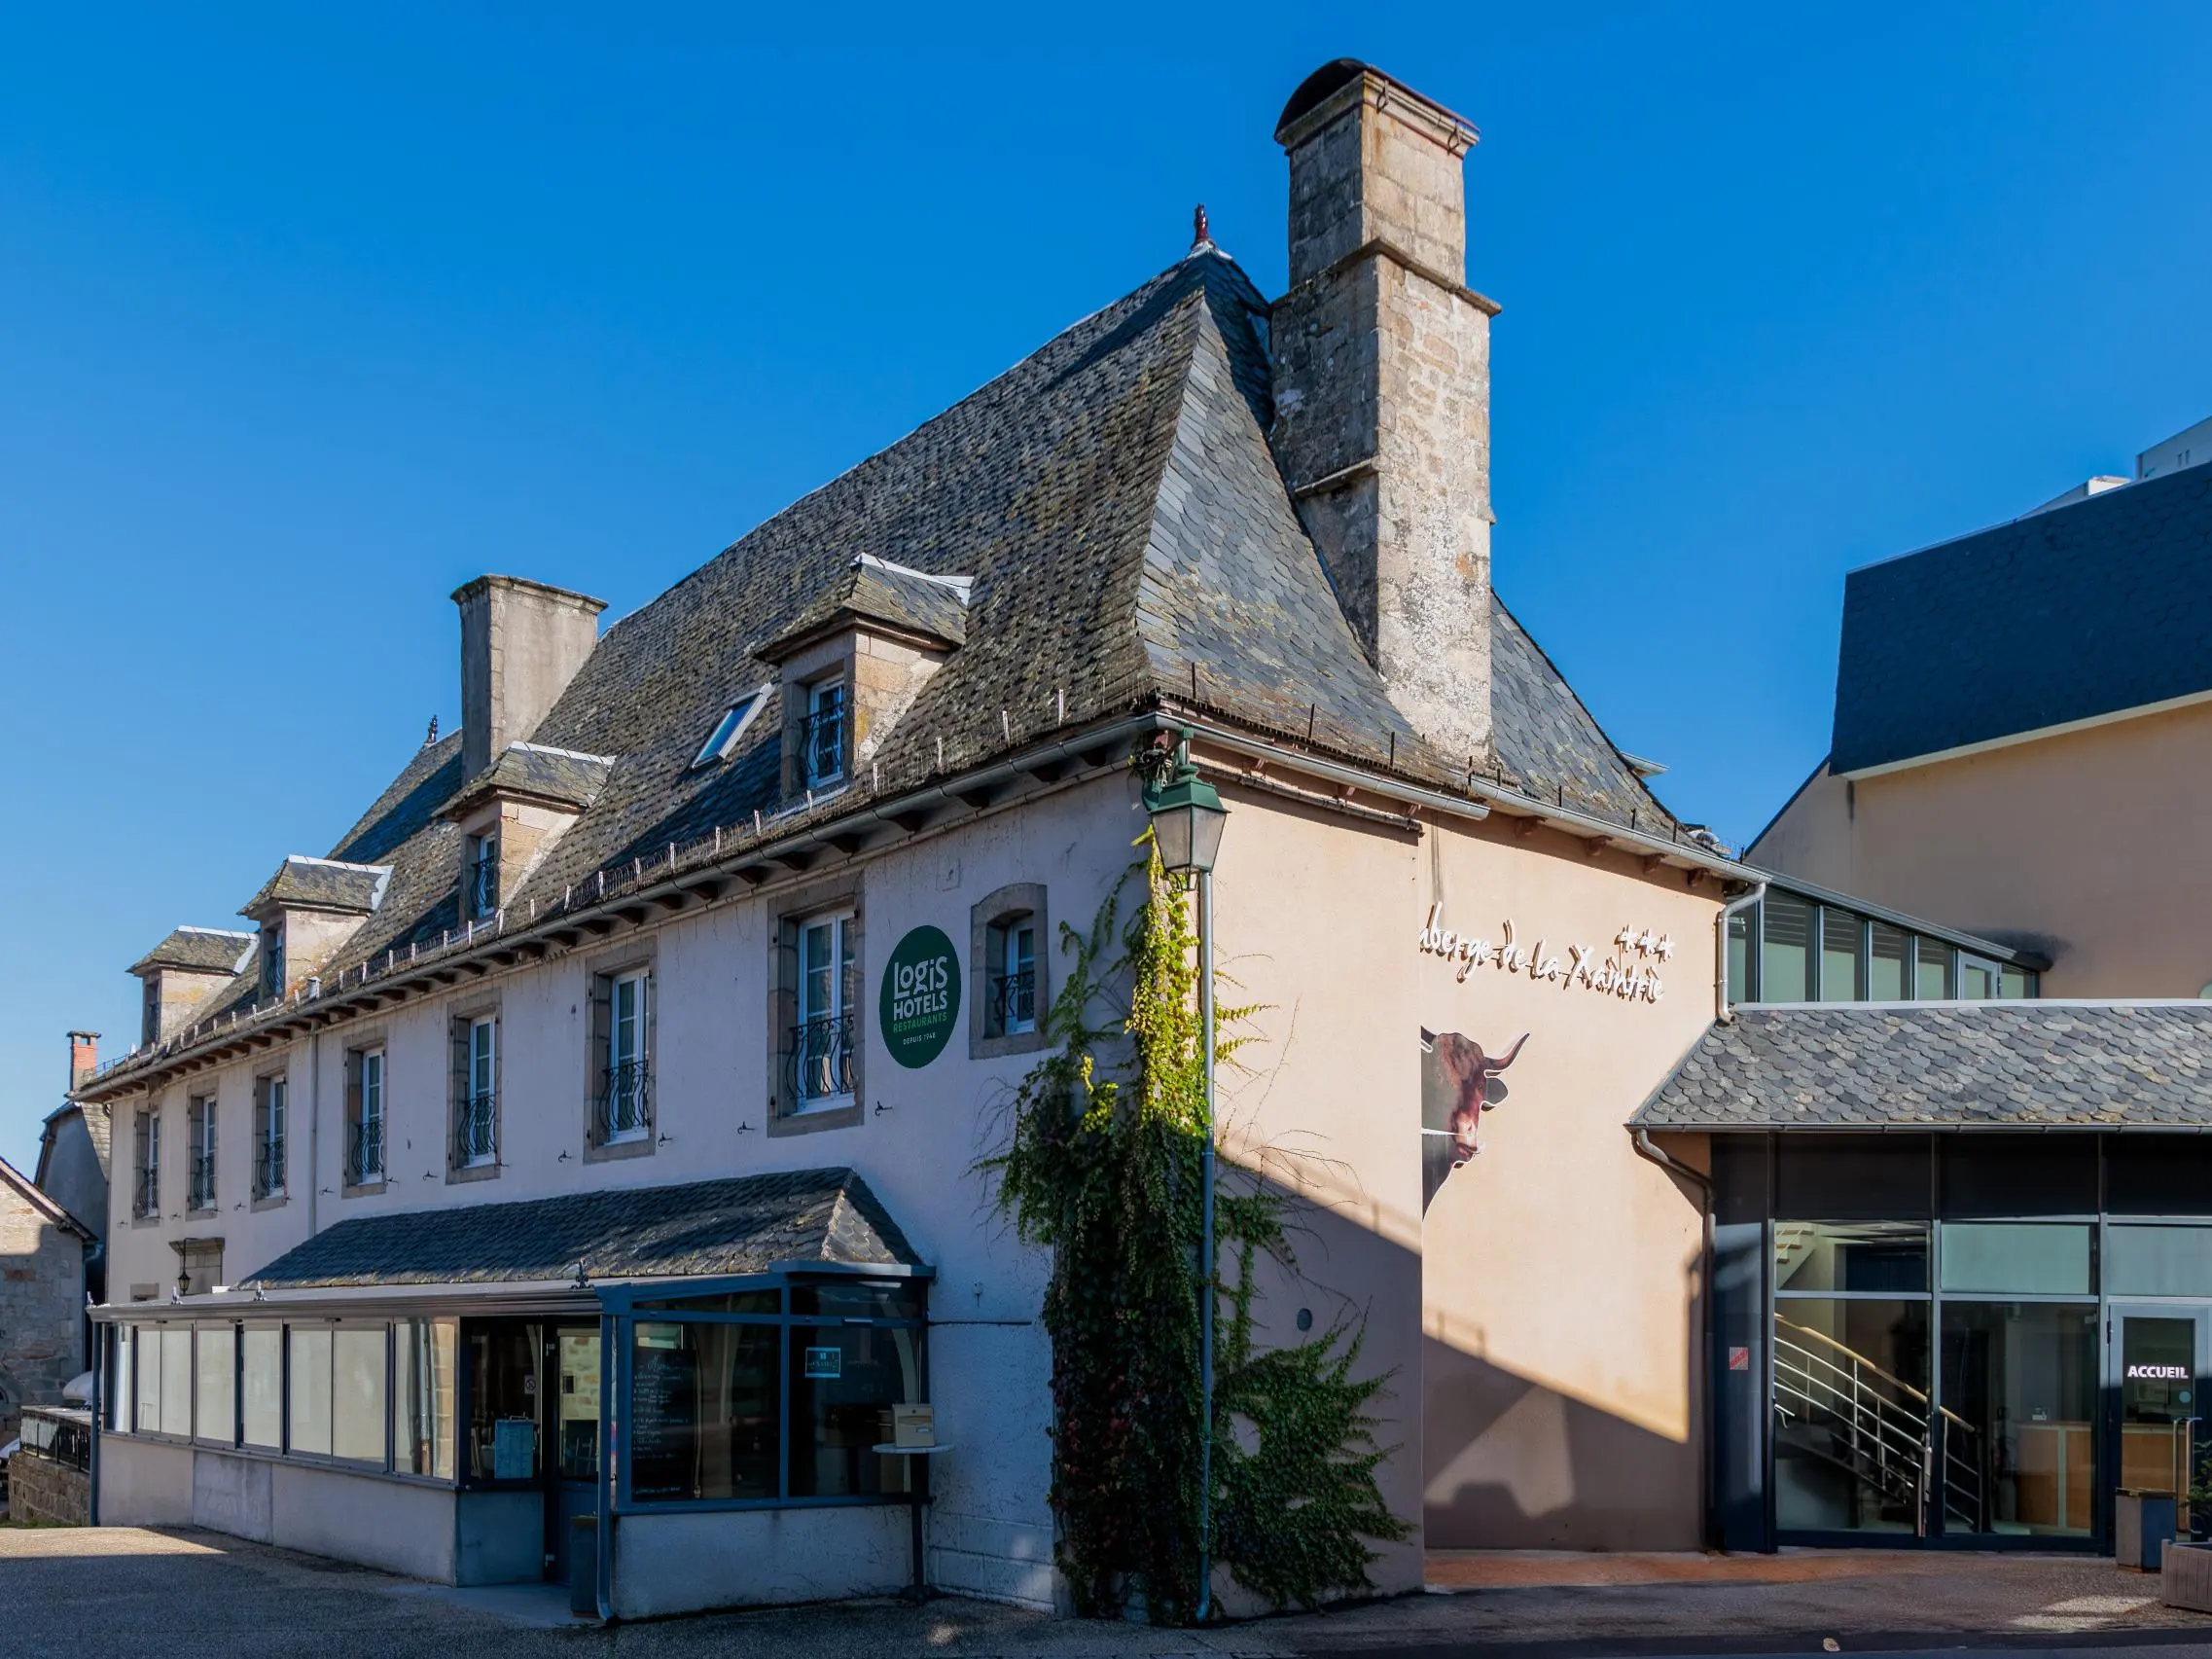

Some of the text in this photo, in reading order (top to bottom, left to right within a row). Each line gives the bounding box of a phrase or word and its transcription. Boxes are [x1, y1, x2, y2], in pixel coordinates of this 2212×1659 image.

[1501, 919, 1527, 968] de
[1535, 939, 1559, 977] la
[893, 990, 948, 1022] HOTELS
[893, 1011, 947, 1033] RESTAURANTS
[903, 1034, 922, 1046] DEPUIS
[2127, 1365, 2189, 1379] ACCUEIL
